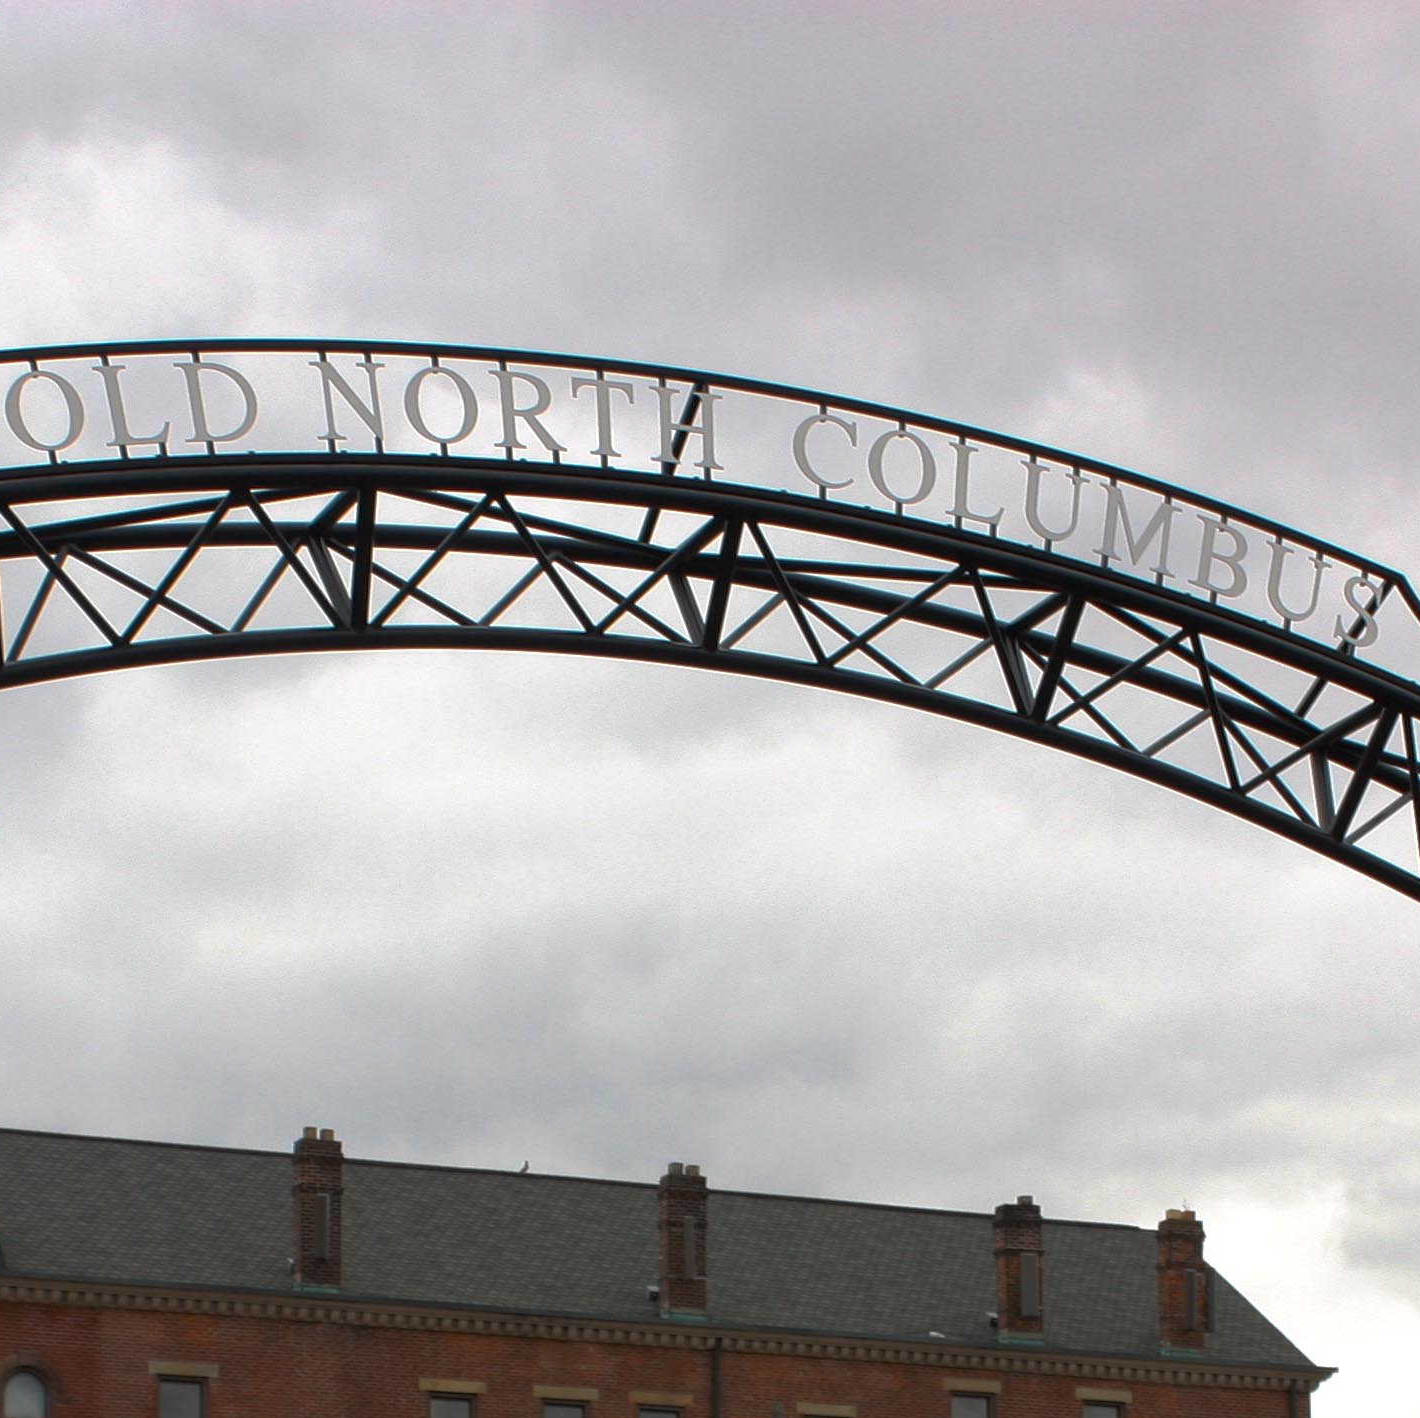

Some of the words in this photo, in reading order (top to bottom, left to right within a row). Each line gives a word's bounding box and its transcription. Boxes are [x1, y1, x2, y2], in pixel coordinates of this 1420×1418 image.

[4, 361, 258, 453] OLD
[309, 360, 724, 472] NORTH
[790, 412, 1382, 649] COLUMBUS
